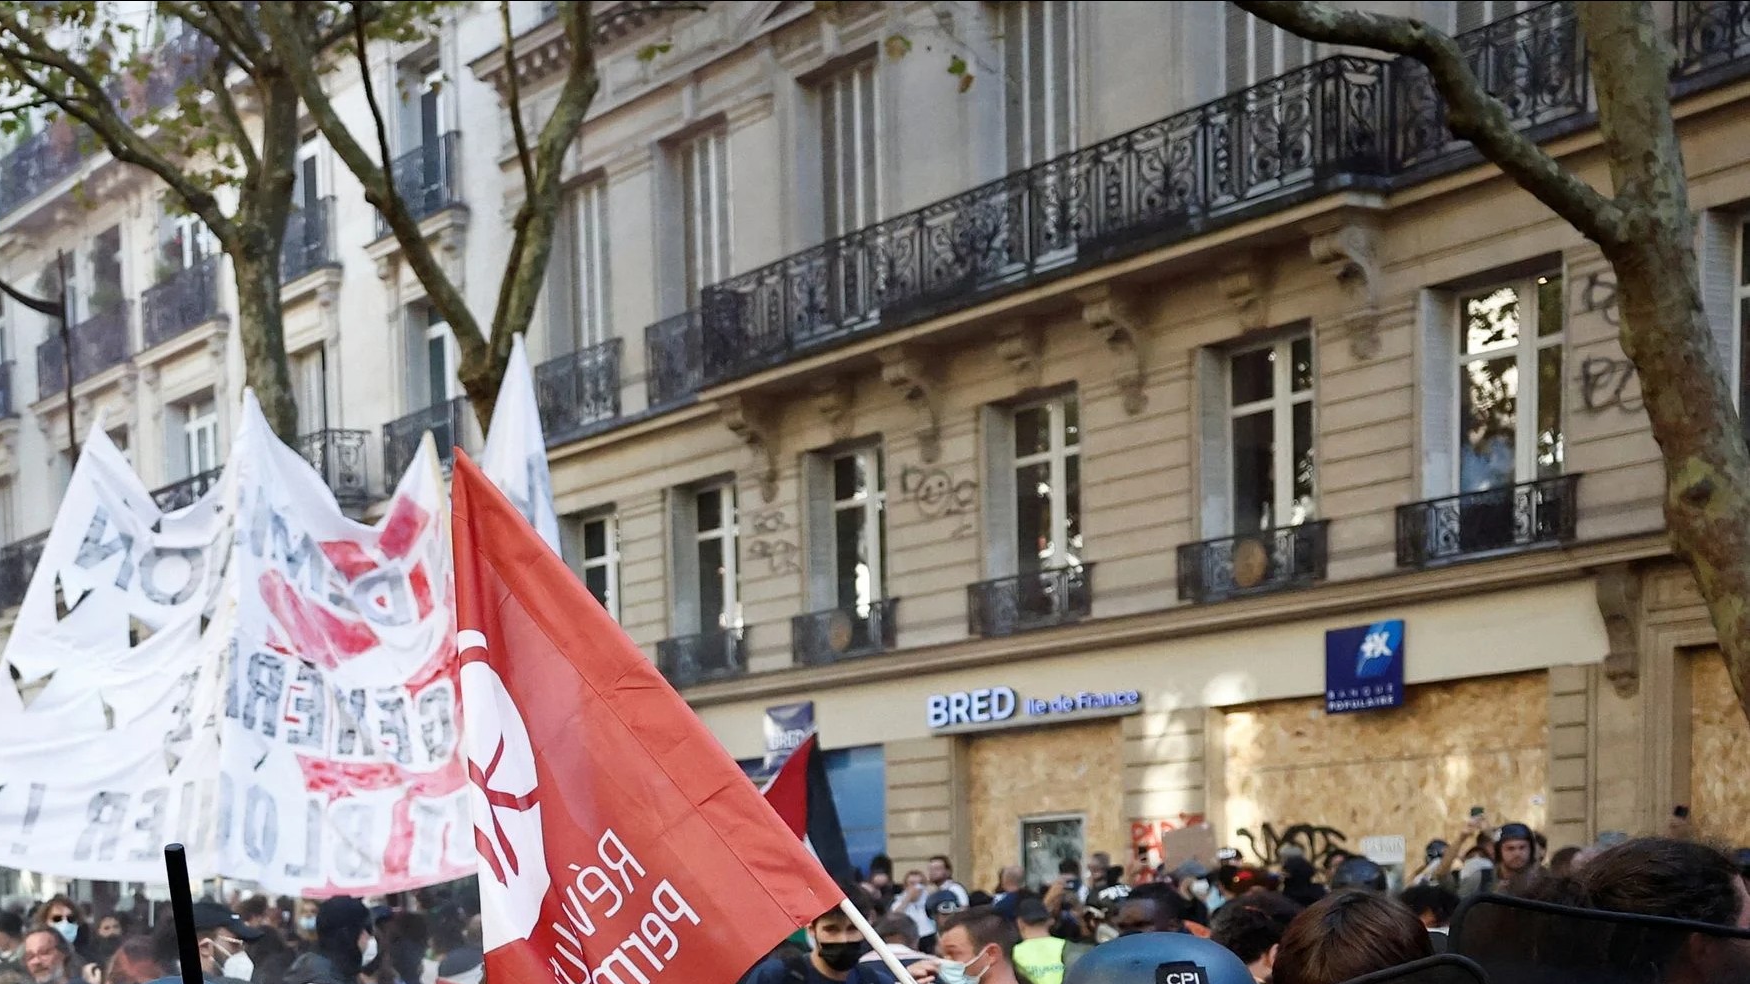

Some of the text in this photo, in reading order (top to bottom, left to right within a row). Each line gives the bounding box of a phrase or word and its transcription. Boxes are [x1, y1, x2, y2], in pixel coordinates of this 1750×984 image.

[927, 686, 1015, 728] BRED
[1050, 694, 1075, 714] de
[1076, 688, 1141, 710] France
